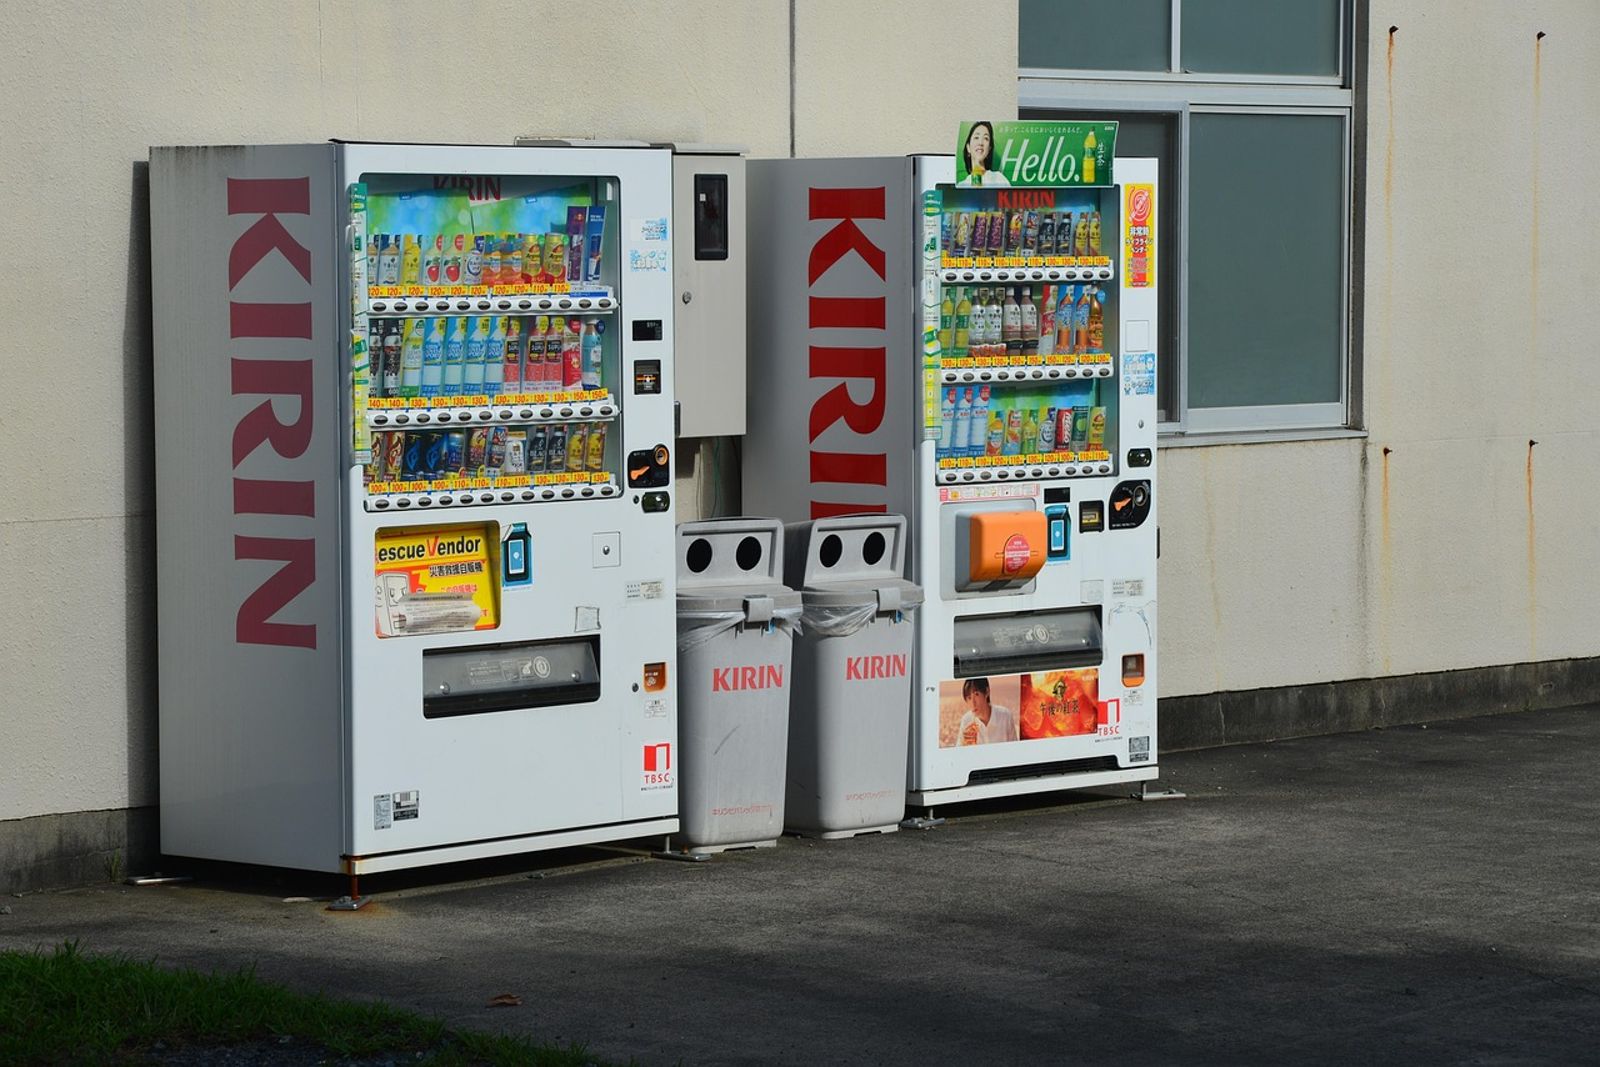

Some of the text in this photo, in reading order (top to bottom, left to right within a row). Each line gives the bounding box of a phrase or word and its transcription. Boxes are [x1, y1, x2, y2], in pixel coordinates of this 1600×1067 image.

[999, 136, 1080, 183] Hello.
[433, 176, 501, 200] KIRIN
[997, 190, 1056, 208] KIRIN
[808, 186, 887, 520] KIRI
[227, 177, 317, 650] KIRIN
[376, 535, 481, 562] escue Vendor
[429, 562, 483, 577] 災害救援自販機
[712, 665, 783, 692] KIRIN
[846, 654, 906, 681] KIRIN
[1040, 700, 1079, 717] 午後の紅茶
[1098, 725, 1120, 736] TBSC
[644, 772, 669, 785] TBSC
